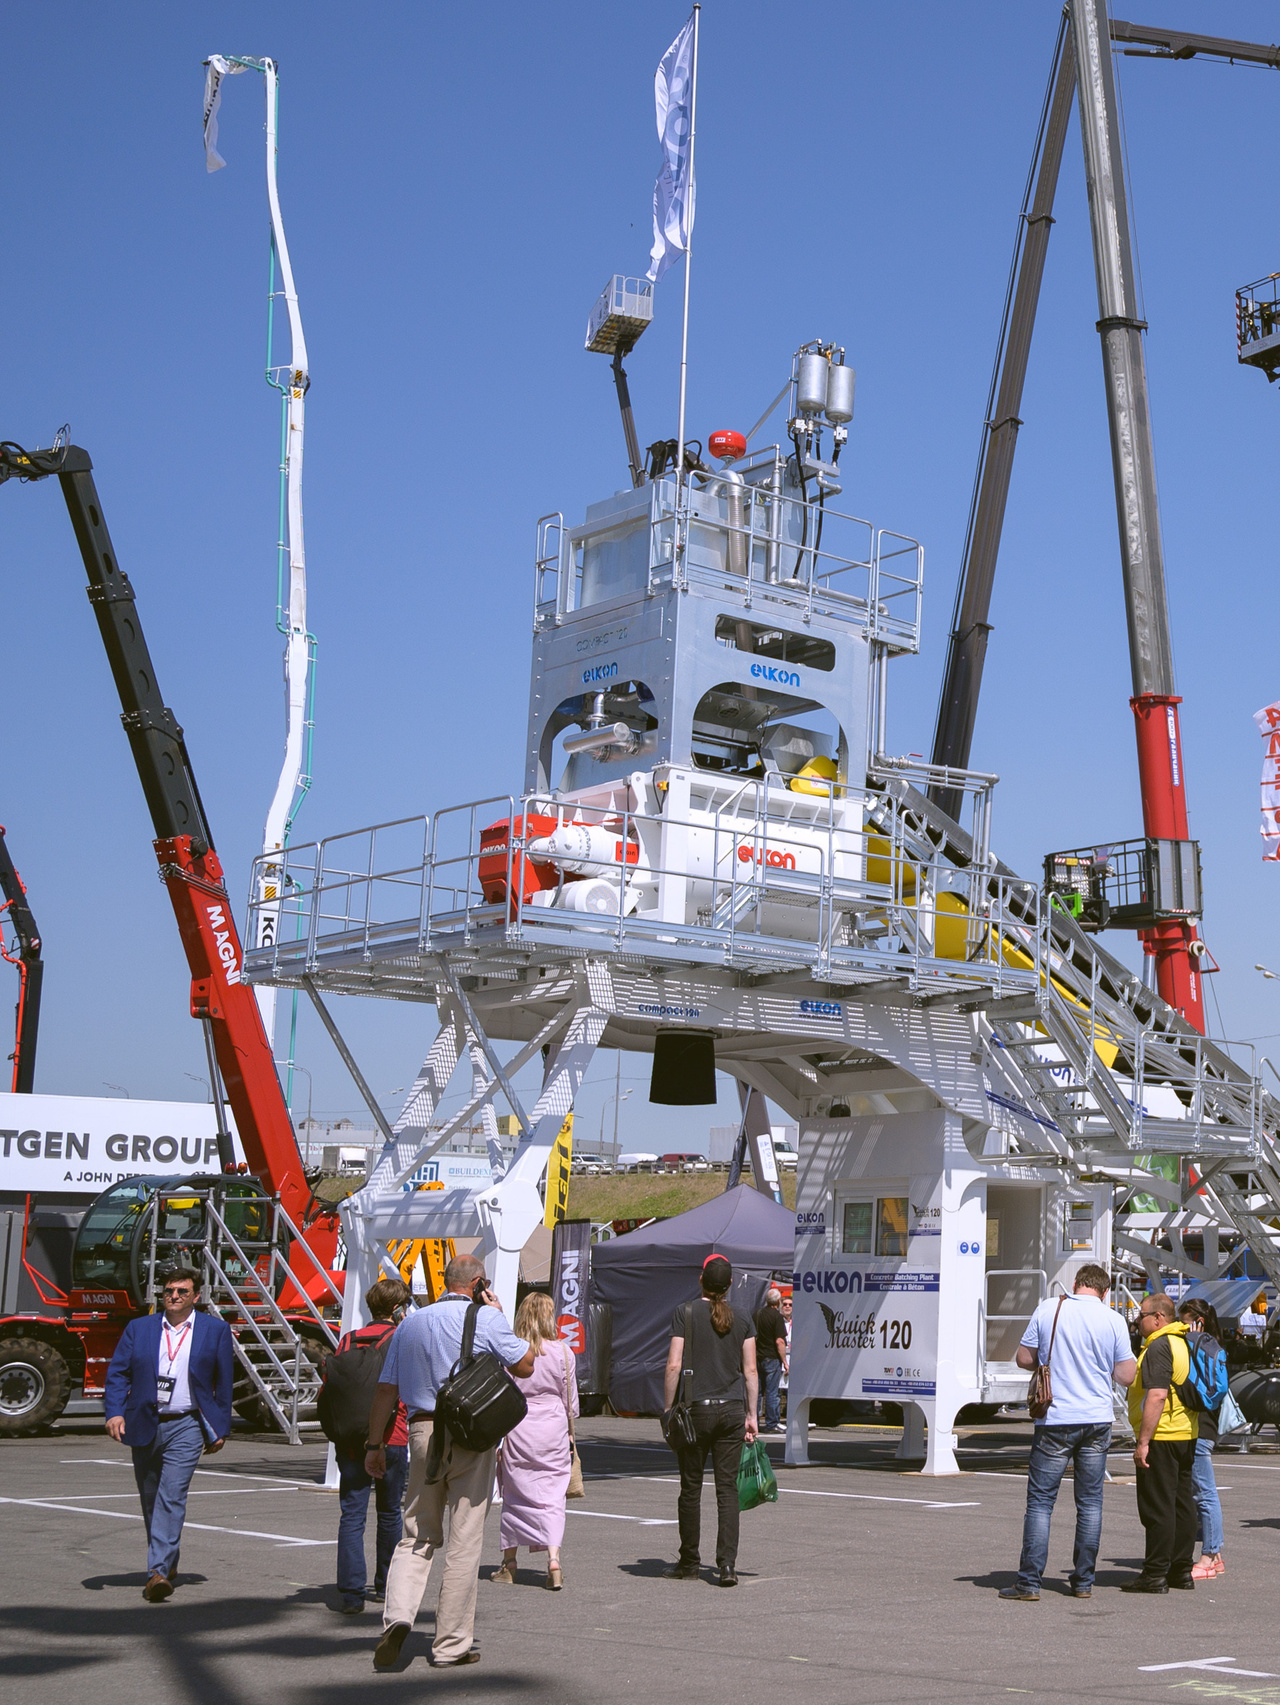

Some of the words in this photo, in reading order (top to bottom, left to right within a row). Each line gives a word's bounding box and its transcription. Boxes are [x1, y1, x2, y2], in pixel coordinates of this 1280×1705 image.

[582, 662, 619, 684] elkon
[750, 663, 801, 688] elkon
[737, 845, 796, 870] elkon
[206, 905, 241, 986] MAGNI
[801, 1000, 842, 1016] elkon
[105, 1133, 220, 1165] GROUP
[76, 1171, 113, 1183] JOHN
[797, 1212, 825, 1223] elkon
[802, 1271, 862, 1293] elkon
[895, 1274, 918, 1282] Batching
[82, 1293, 116, 1304] MAGNI
[560, 1249, 580, 1348] MAGNI
[833, 1311, 876, 1335] Quick
[825, 1331, 876, 1349] Master
[880, 1320, 912, 1350] 120
[157, 1381, 170, 1390] VIP
